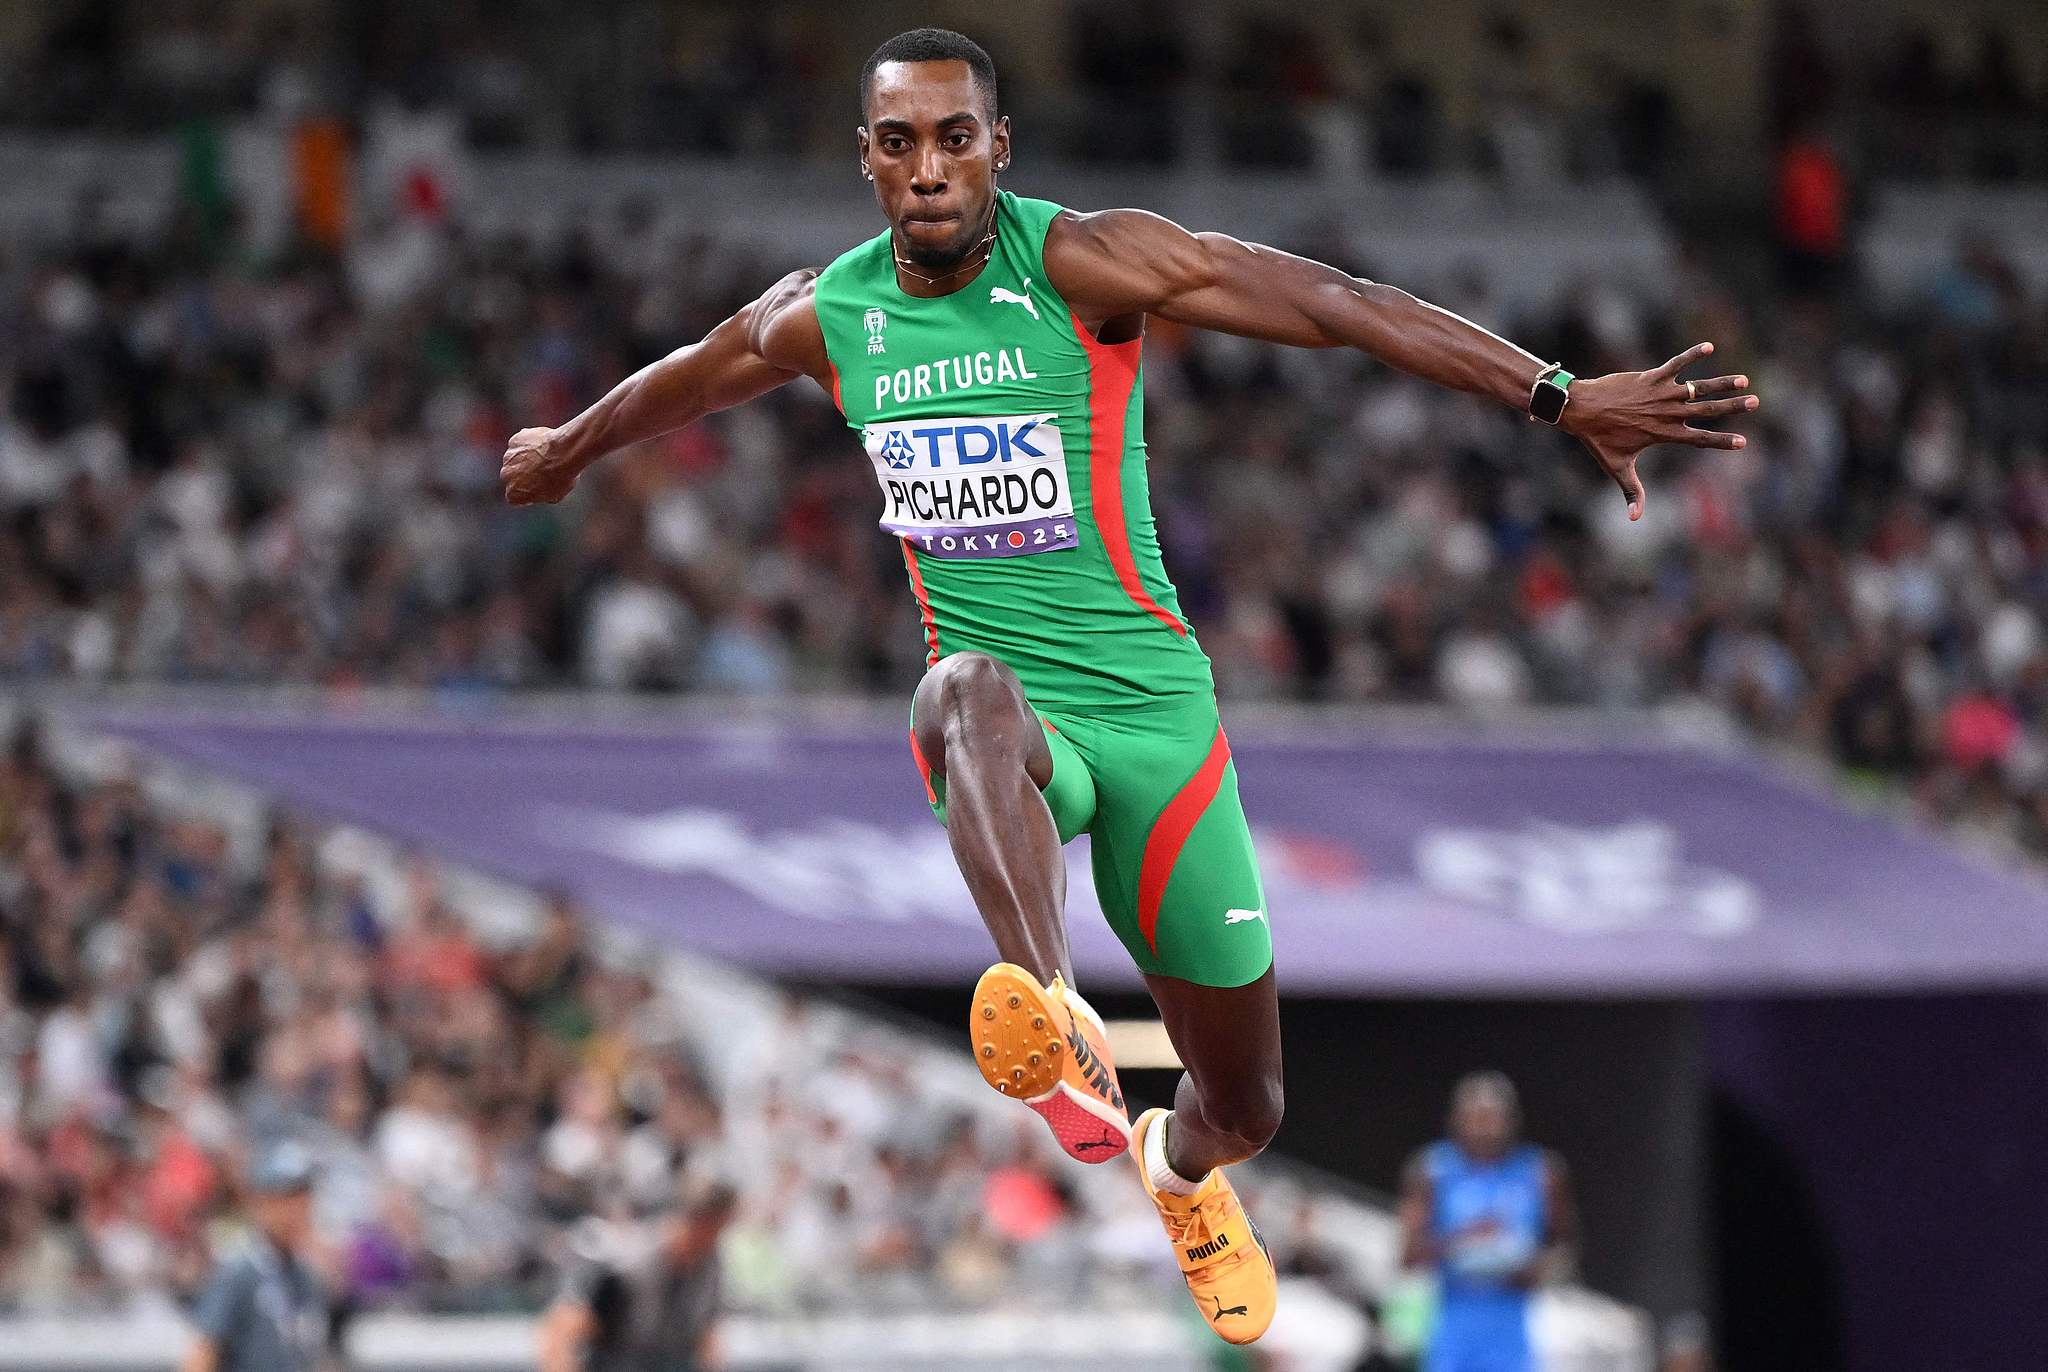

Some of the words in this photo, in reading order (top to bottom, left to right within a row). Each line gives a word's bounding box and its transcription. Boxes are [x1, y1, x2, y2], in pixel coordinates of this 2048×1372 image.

[867, 343, 886, 356] FPA
[875, 347, 1037, 411] PORTUGAL
[912, 421, 1047, 468] TDK
[887, 467, 1058, 521] PICHARDO
[1186, 1233, 1230, 1262] PUMA
